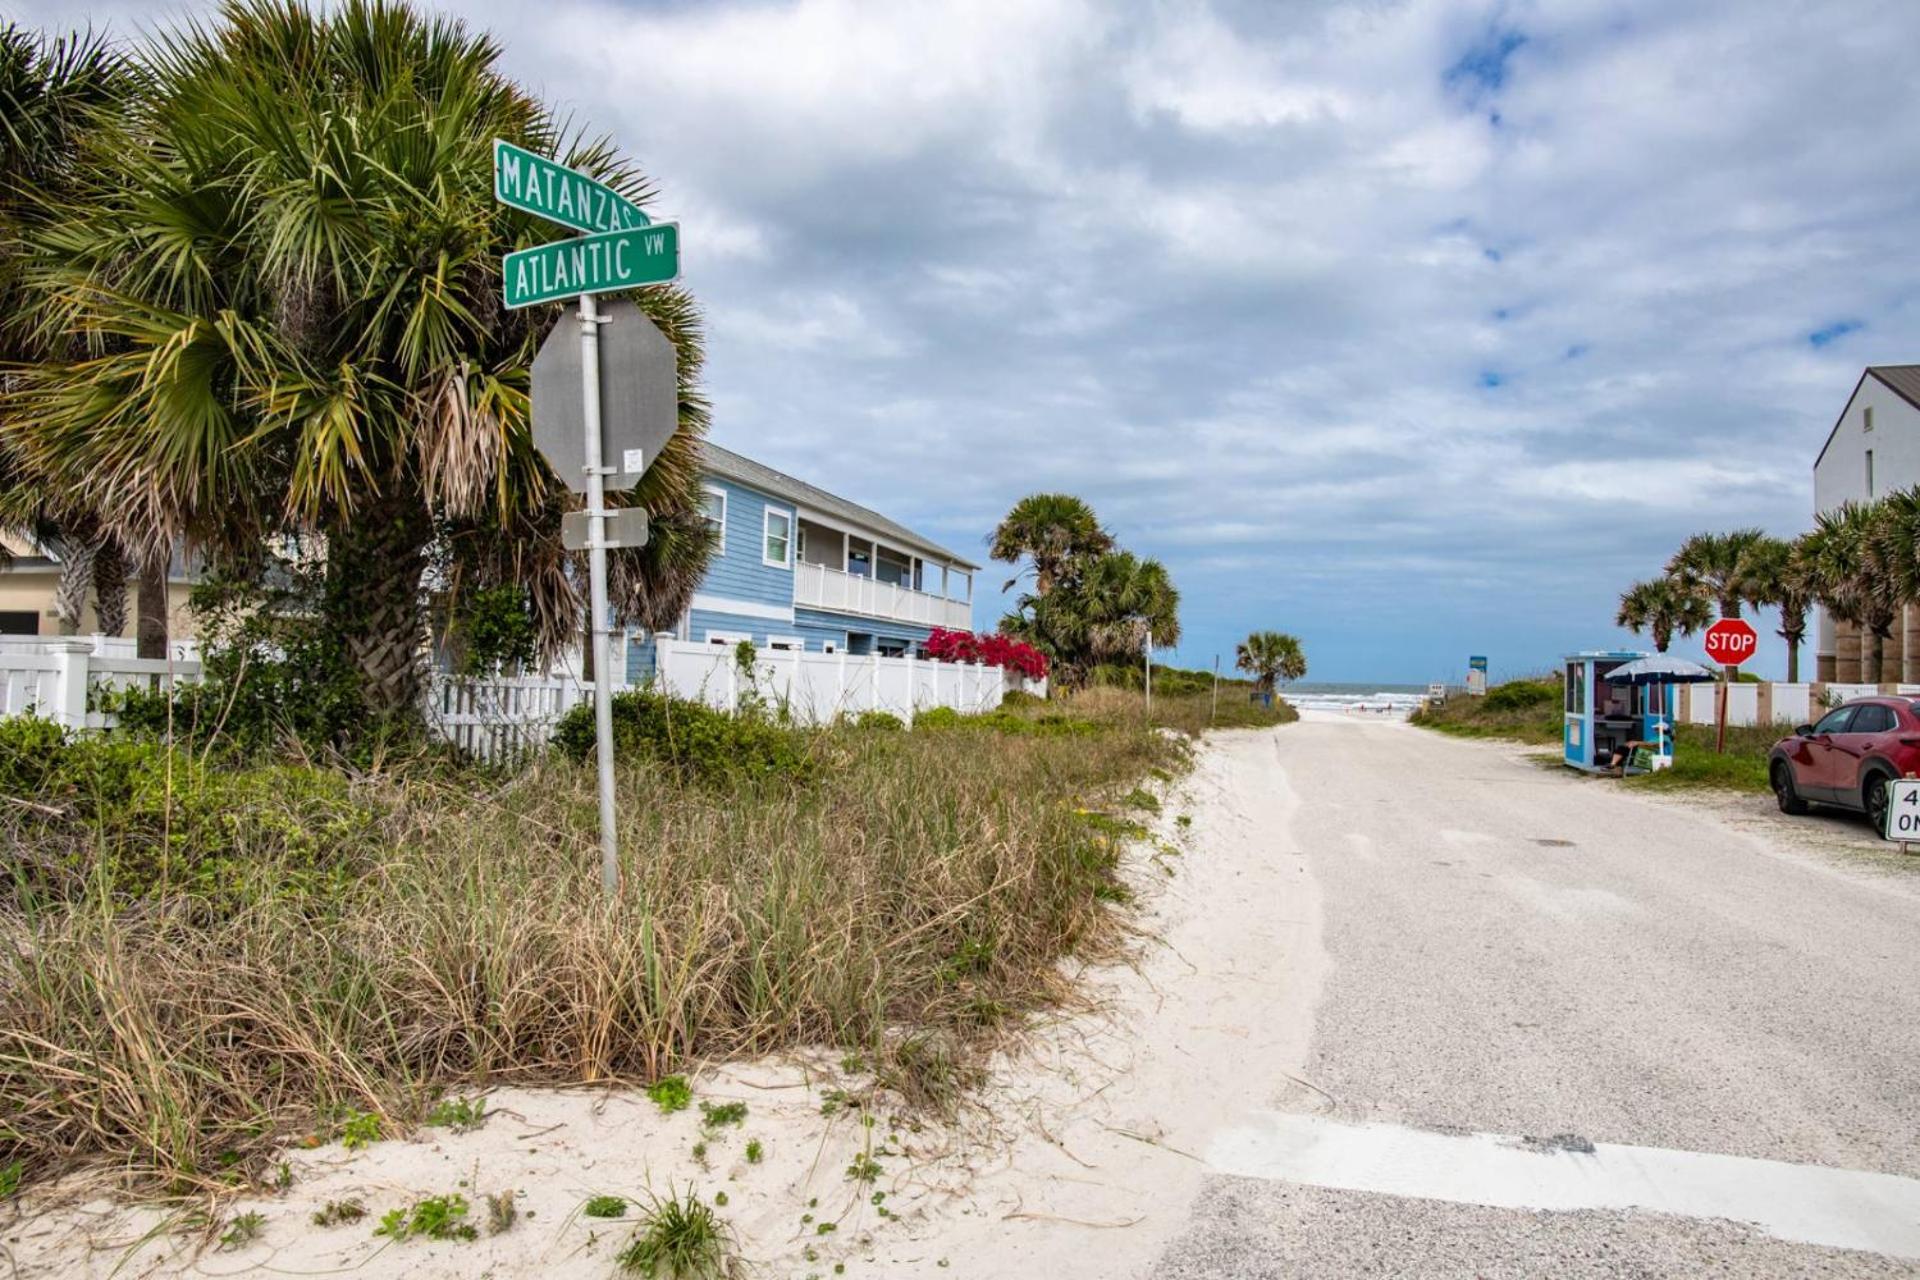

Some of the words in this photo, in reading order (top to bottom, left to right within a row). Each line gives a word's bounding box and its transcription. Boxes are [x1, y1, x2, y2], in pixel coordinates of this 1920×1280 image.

[515, 238, 631, 299] ATLANTIC
[644, 232, 665, 256] VW
[1708, 632, 1754, 652] STOP
